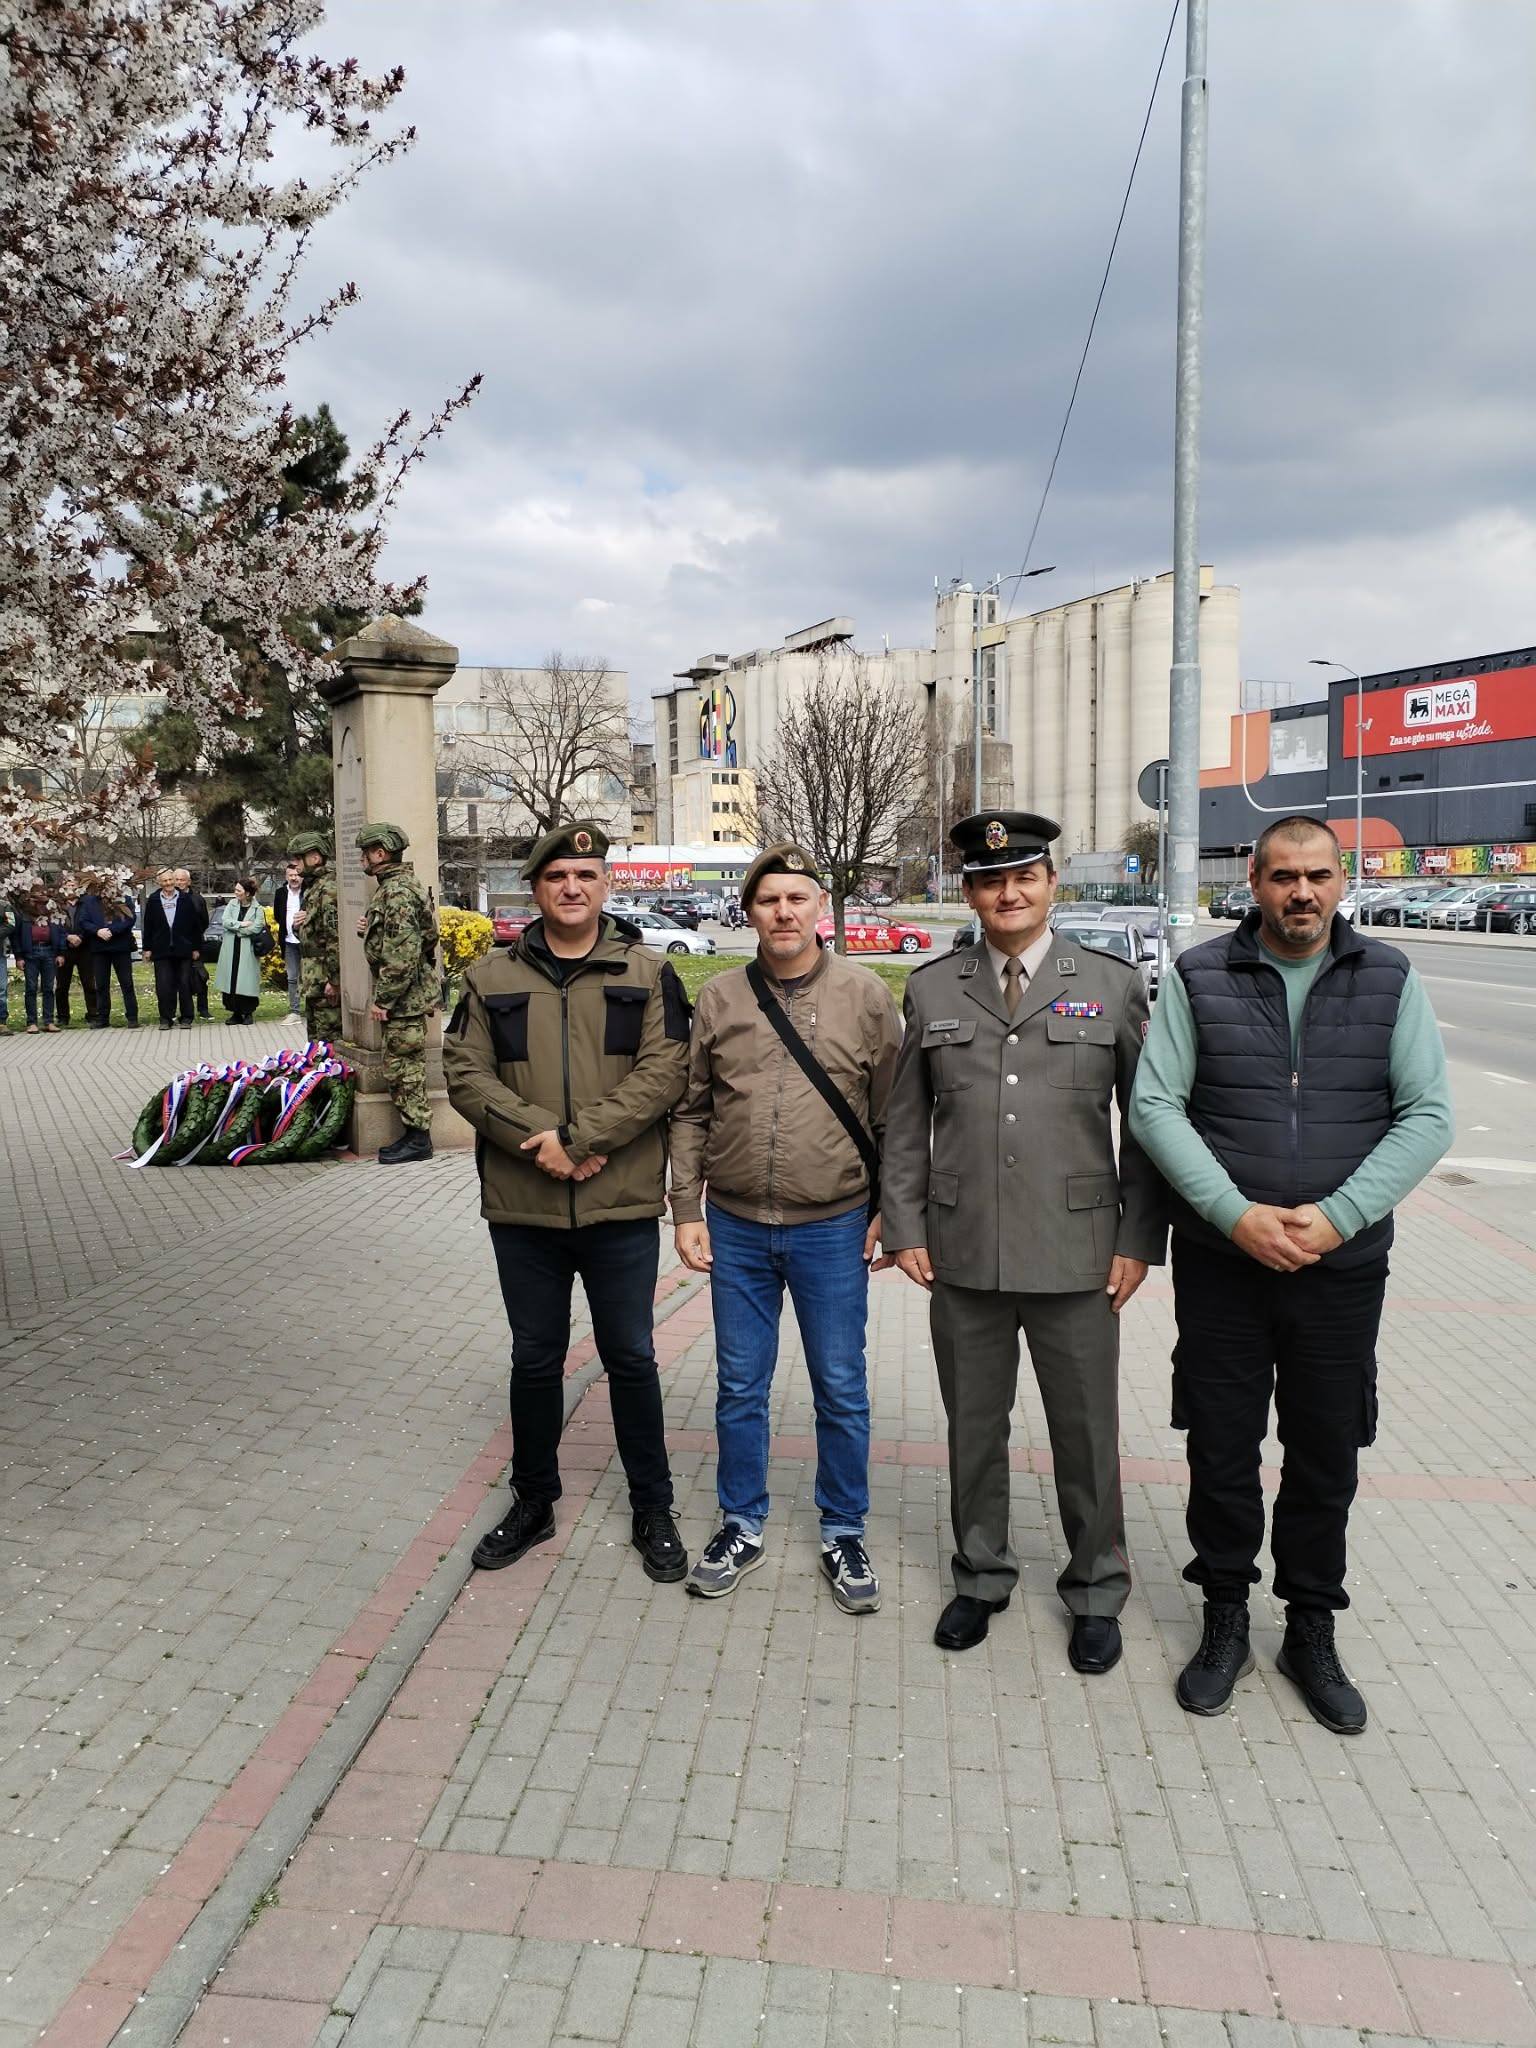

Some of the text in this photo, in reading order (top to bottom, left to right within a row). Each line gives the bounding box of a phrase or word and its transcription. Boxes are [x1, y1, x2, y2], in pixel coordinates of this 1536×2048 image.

[1435, 689, 1470, 703] MEGA
[1435, 701, 1470, 718] MAXI
[1426, 733, 1435, 741] su
[1435, 730, 1455, 742] mega
[615, 867, 662, 880] KRALJICA
